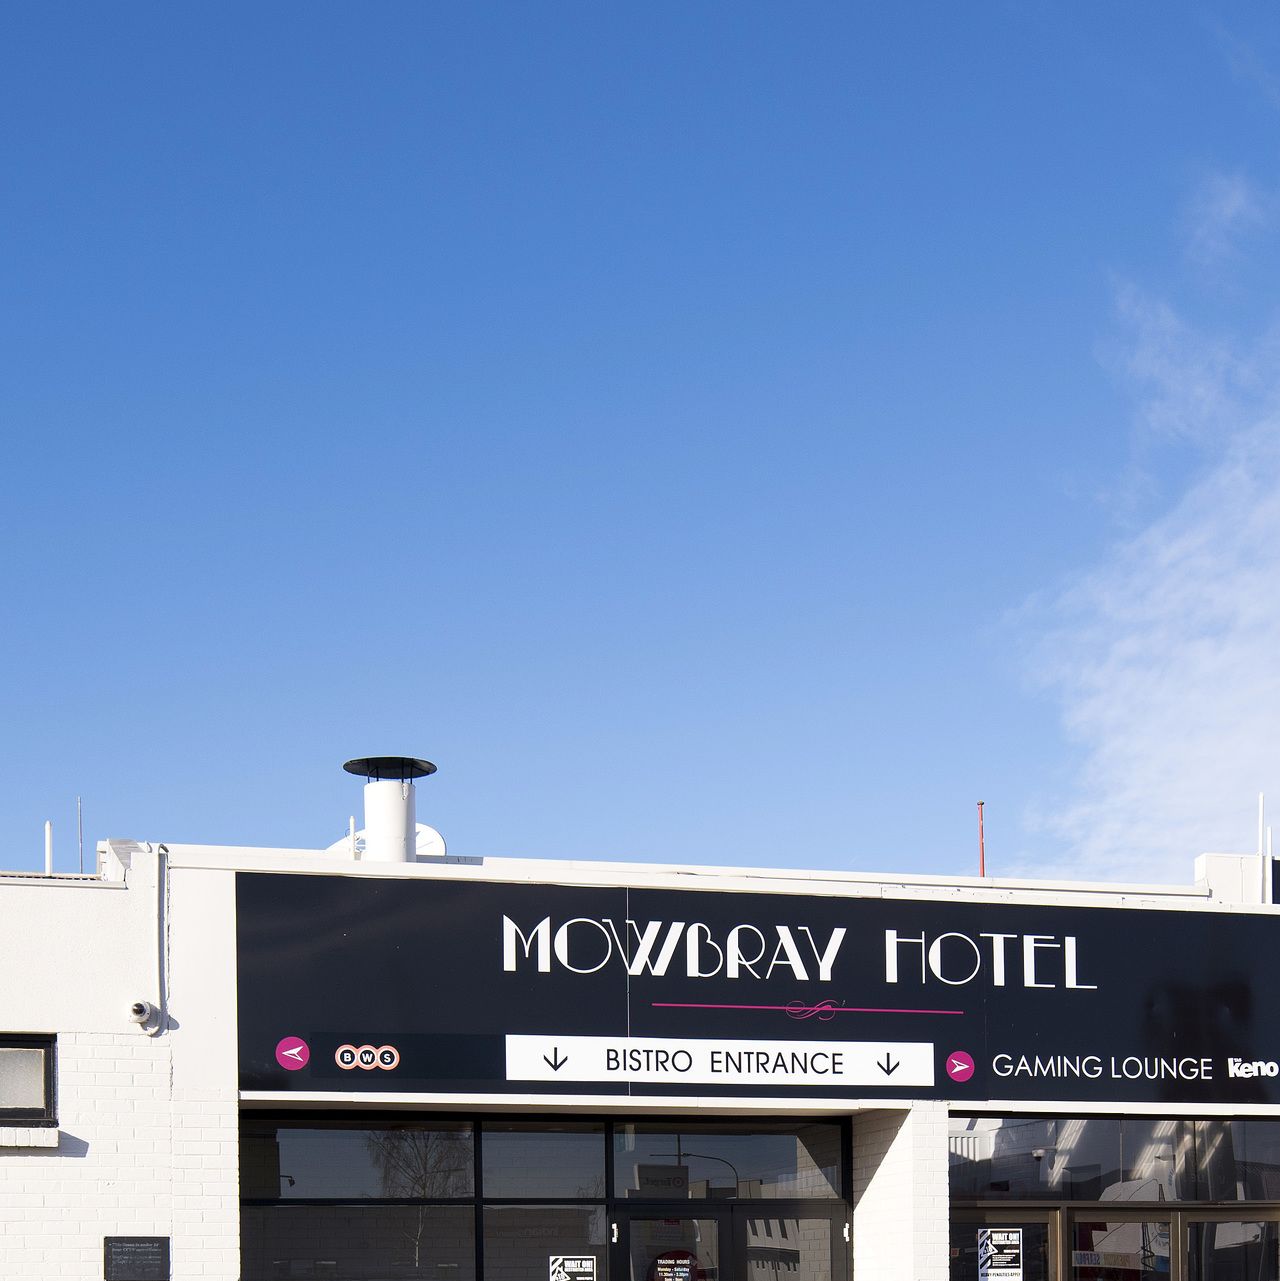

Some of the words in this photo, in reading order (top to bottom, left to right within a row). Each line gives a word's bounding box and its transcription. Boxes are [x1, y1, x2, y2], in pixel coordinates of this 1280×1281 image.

[503, 914, 846, 981] MOWBRAY
[885, 929, 1098, 990] HOTEL
[606, 1049, 693, 1073] BISTRO
[710, 1051, 844, 1075] ENTRANCE
[992, 1054, 1103, 1078] GAMING
[1111, 1057, 1213, 1080] LOUNGE
[1227, 1057, 1280, 1079] keno
